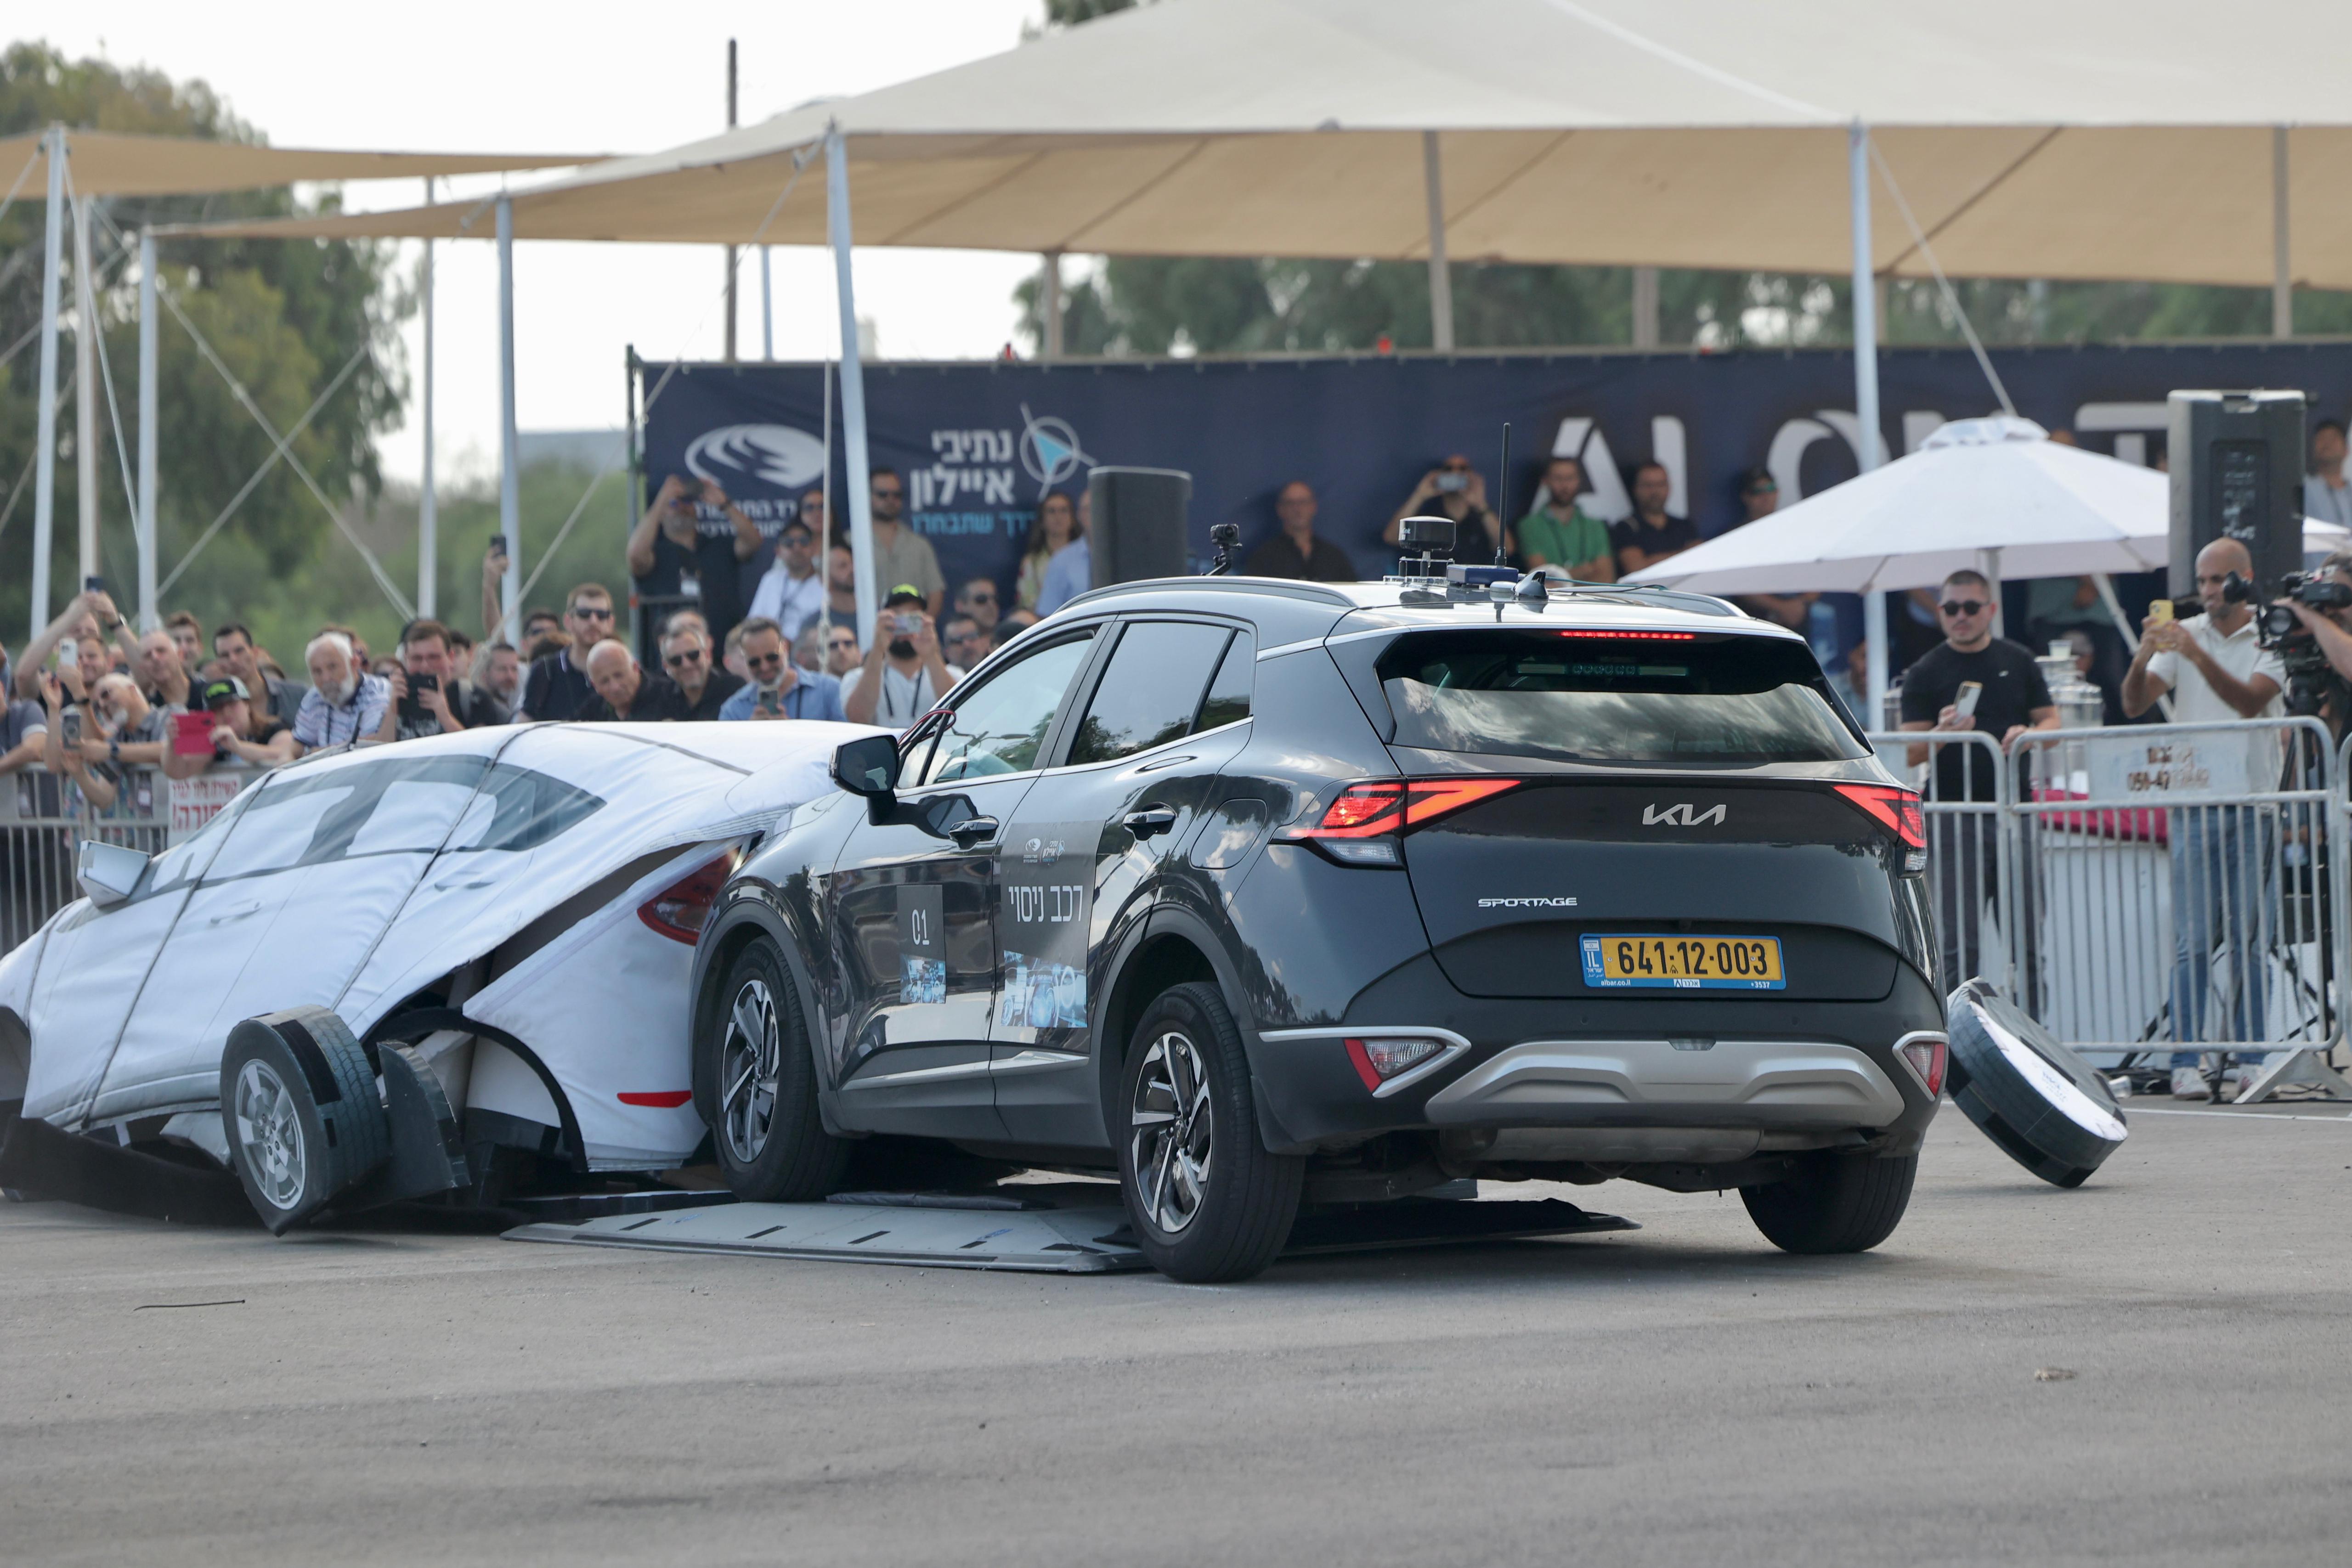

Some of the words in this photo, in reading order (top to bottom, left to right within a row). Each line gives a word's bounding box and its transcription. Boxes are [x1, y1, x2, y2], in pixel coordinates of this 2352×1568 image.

[931, 429, 1013, 463] נתיבי
[910, 462, 1014, 512] איילון
[1008, 886, 1044, 922] ניסוי
[1050, 886, 1083, 922] רכב
[1478, 897, 1577, 907] SPORTAGE
[912, 909, 929, 945] 01
[1587, 952, 1600, 967] IL
